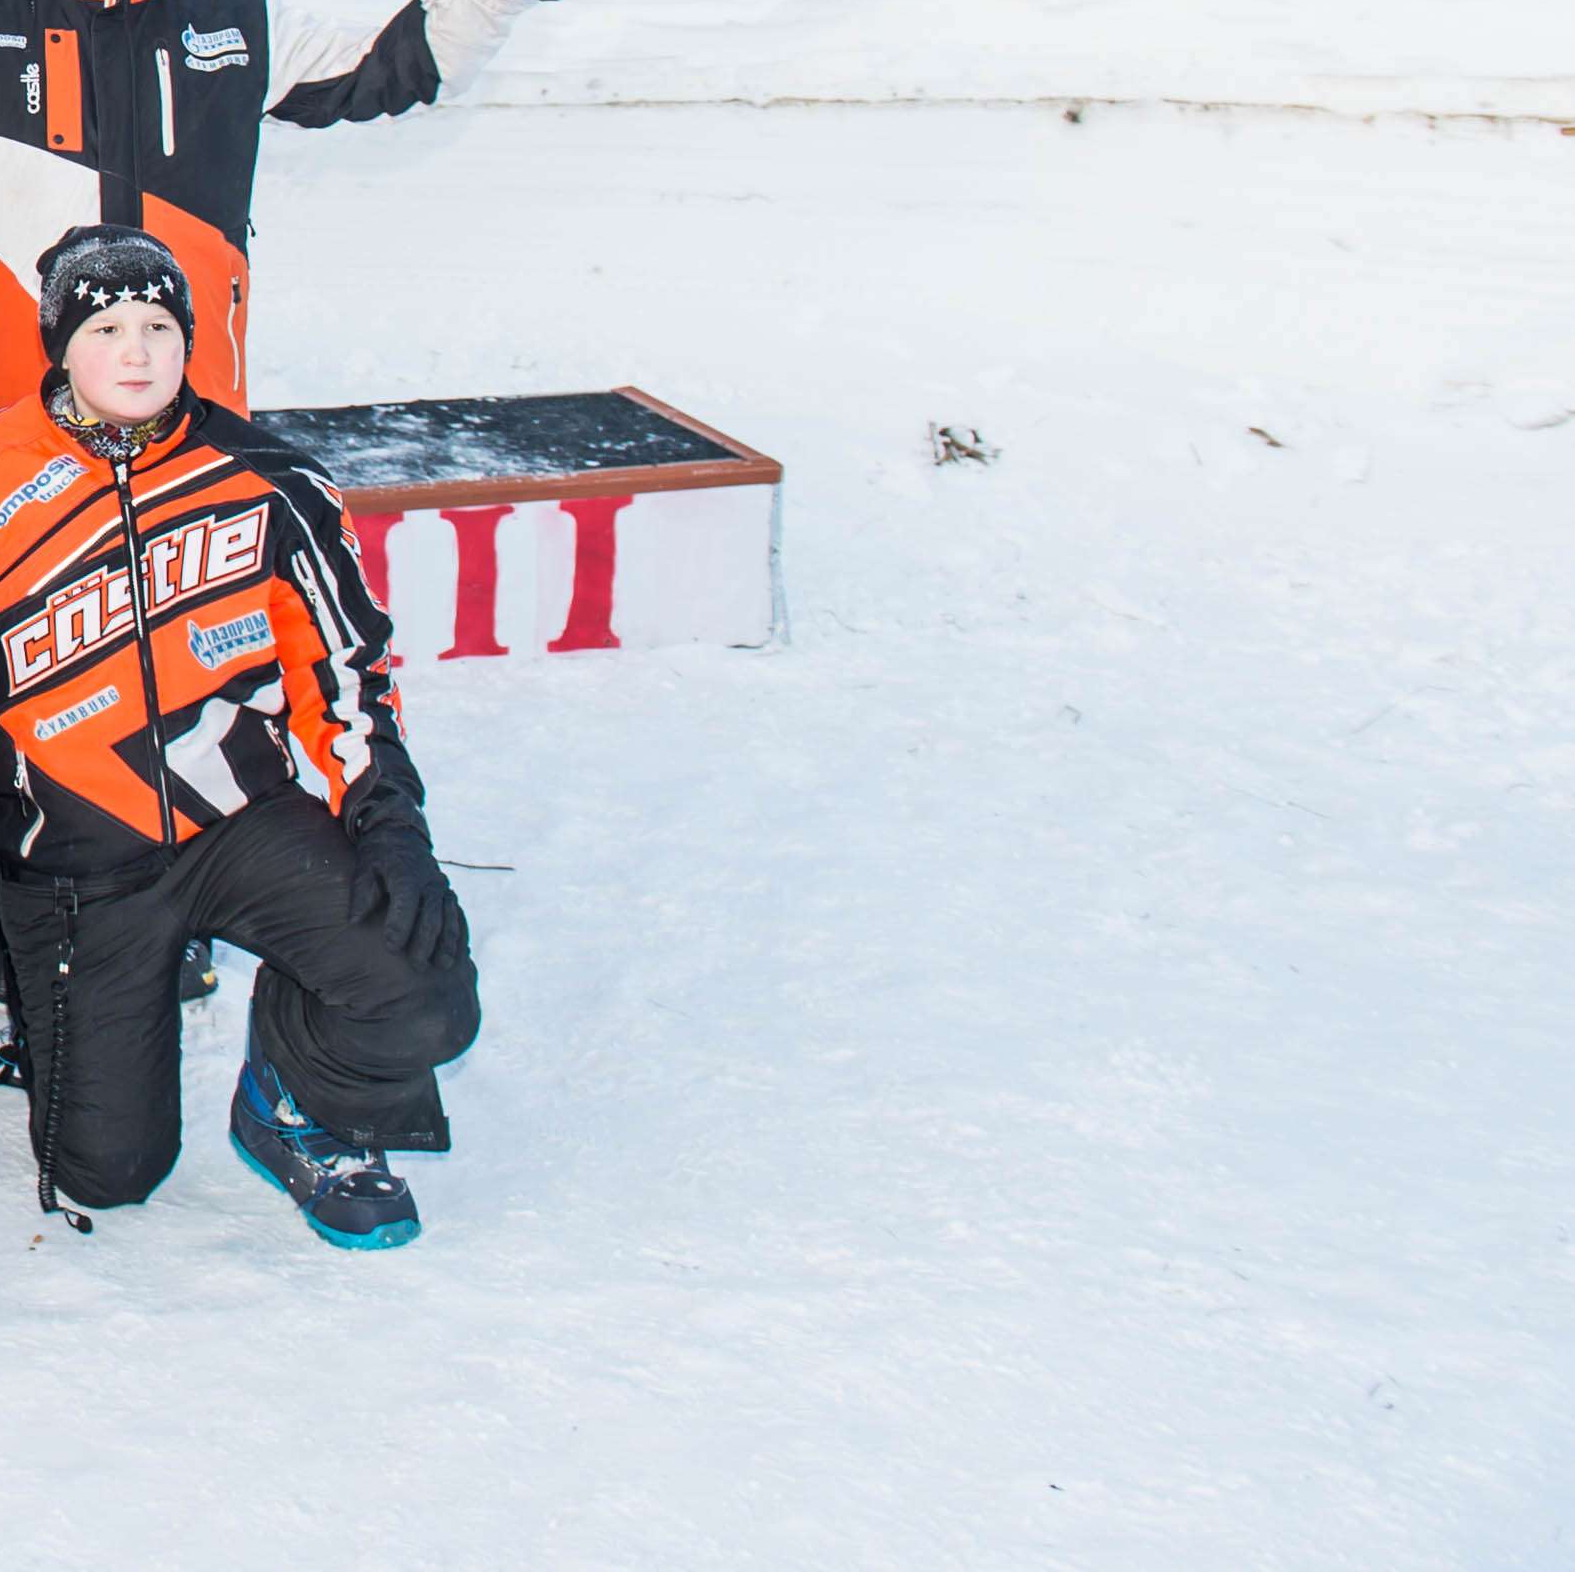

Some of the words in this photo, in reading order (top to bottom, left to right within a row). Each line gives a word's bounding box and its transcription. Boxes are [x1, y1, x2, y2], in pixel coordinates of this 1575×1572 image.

[19, 62, 41, 115] castle
[38, 464, 89, 502] tracks
[204, 610, 269, 646] ГАЗПРОМ
[47, 686, 120, 736] YAMBURG
